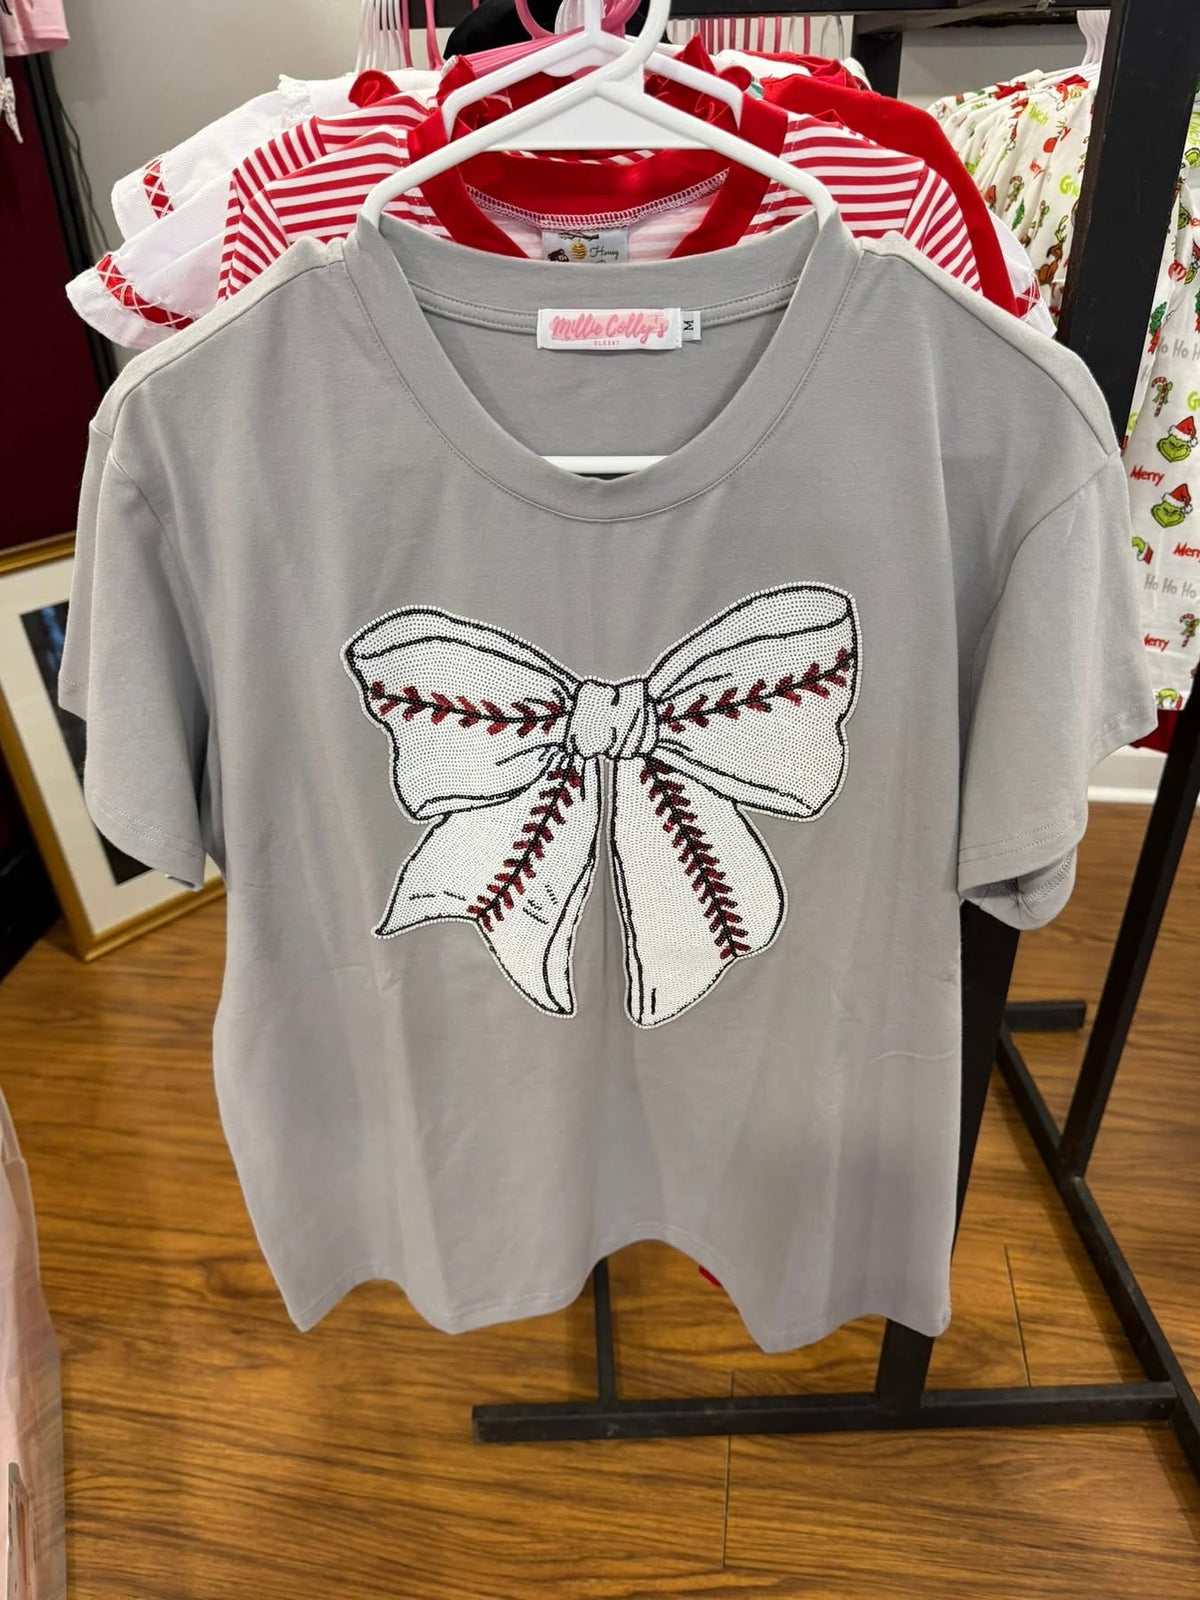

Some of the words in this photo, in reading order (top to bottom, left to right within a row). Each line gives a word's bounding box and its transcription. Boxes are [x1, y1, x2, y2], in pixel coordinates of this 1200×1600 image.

[589, 245, 619, 260] Honey
[605, 313, 668, 344] Colly's
[683, 319, 694, 331] M
[1172, 338, 1188, 358] Ho
[1191, 343, 1200, 361] H
[1130, 465, 1165, 487] Merry
[1173, 541, 1200, 563] Merr
[1144, 573, 1159, 591] Ho
[1161, 577, 1178, 595] Ho
[1181, 581, 1197, 599] Ho
